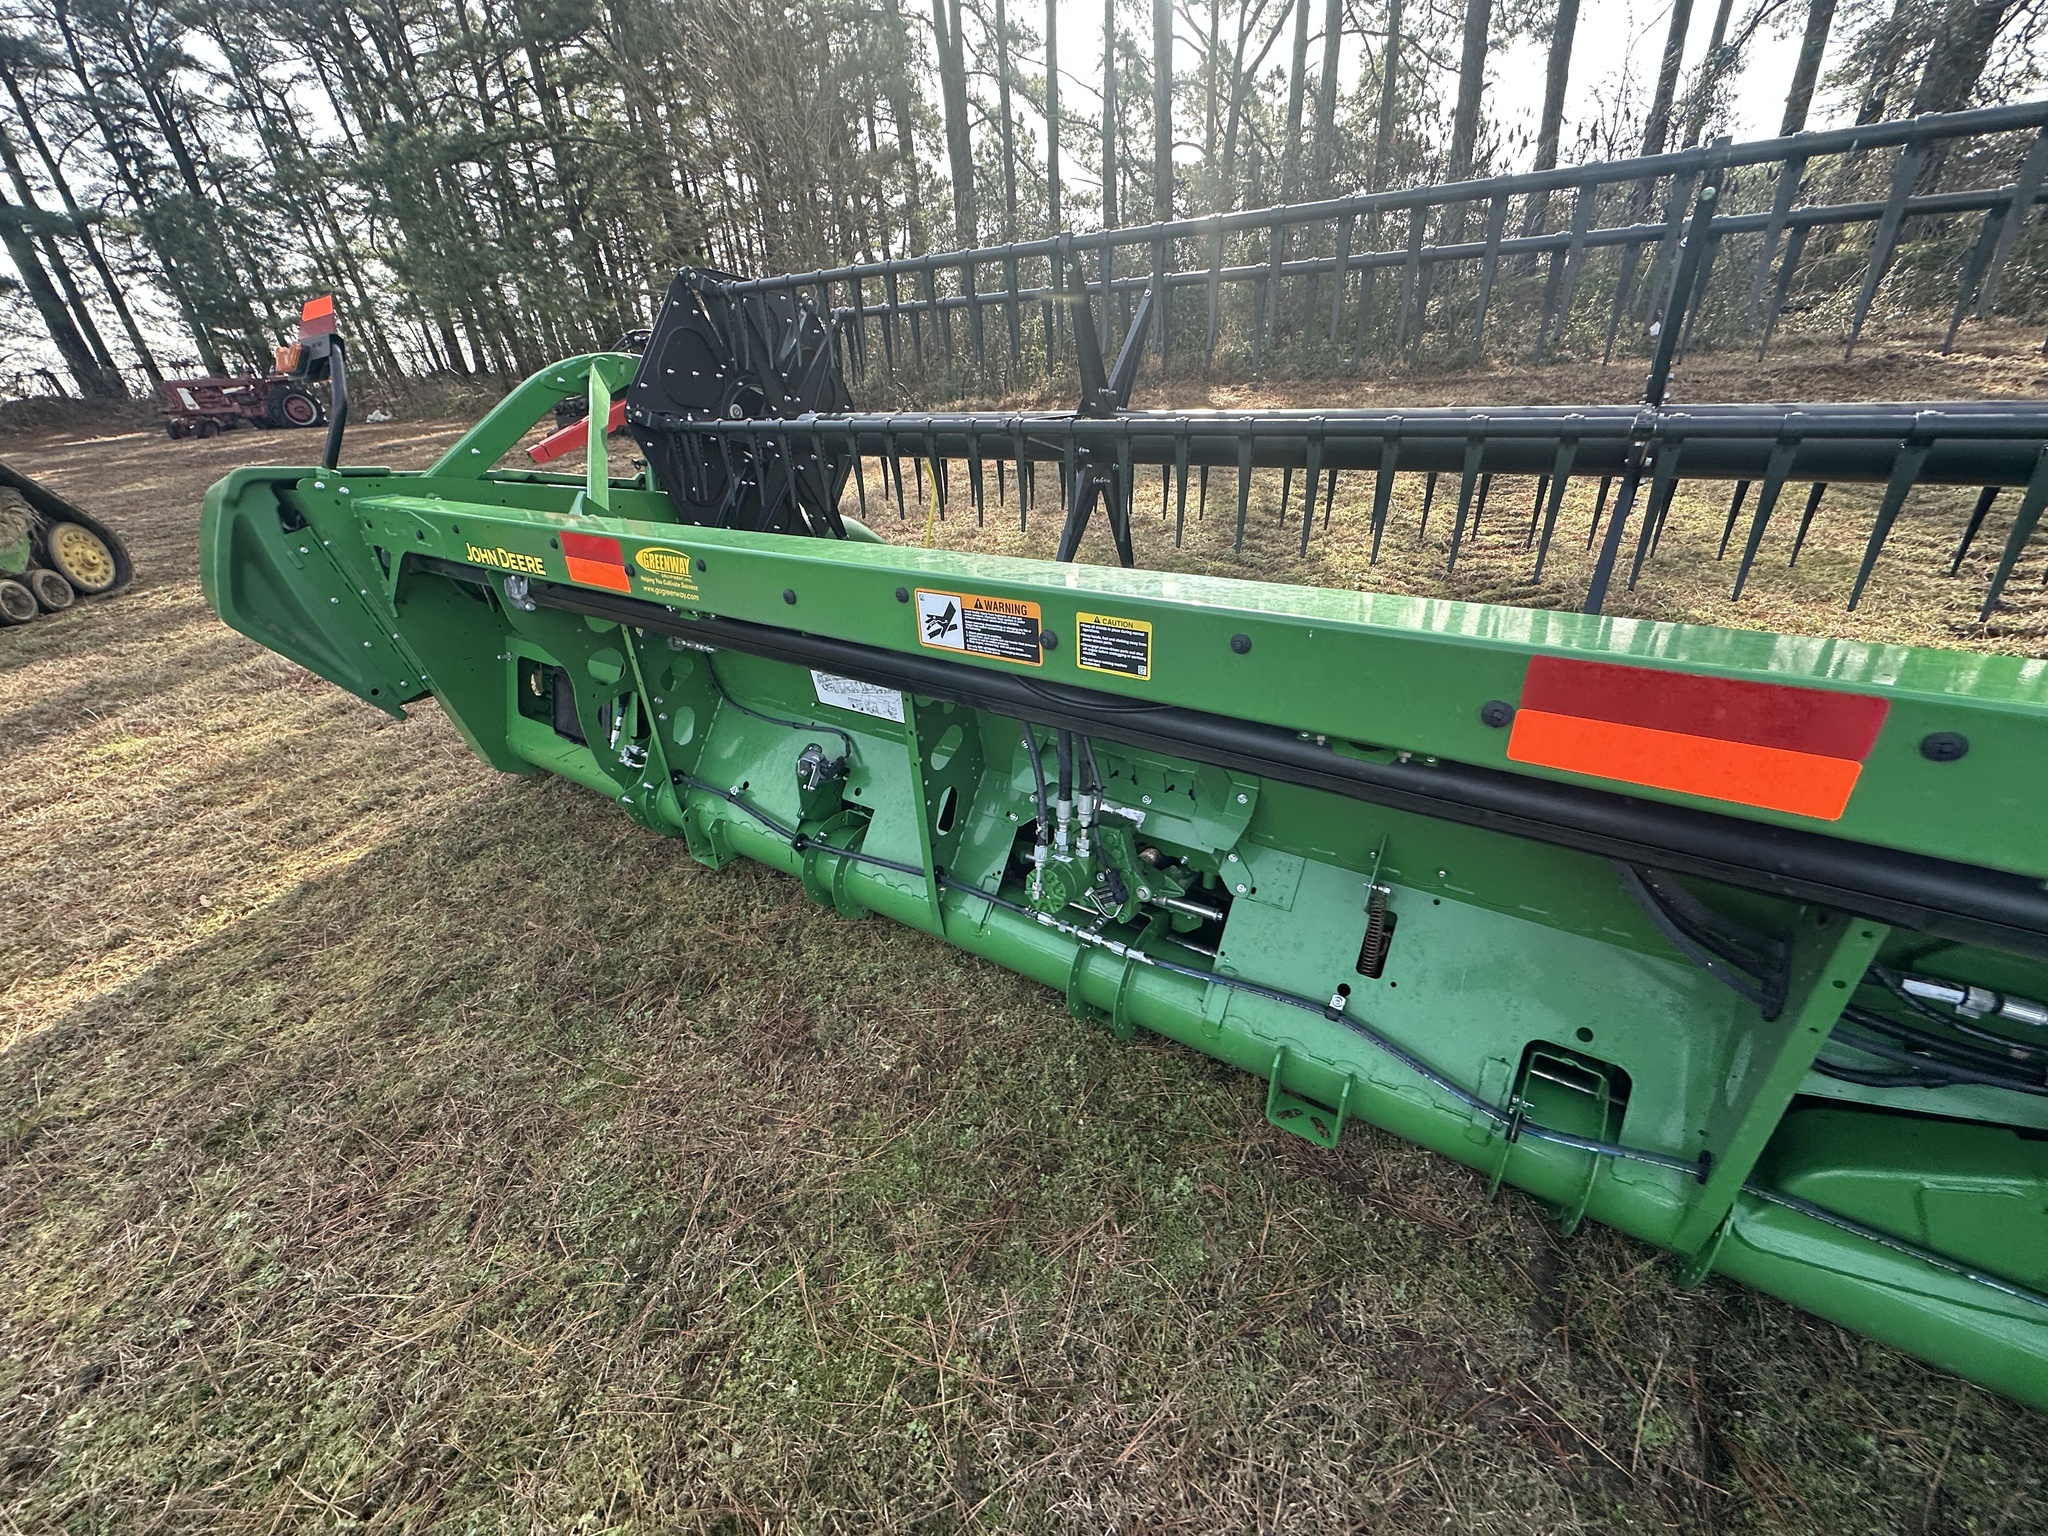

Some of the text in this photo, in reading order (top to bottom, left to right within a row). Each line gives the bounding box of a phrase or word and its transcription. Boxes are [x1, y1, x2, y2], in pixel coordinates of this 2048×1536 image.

[466, 542, 546, 576] JOHN DEERE
[643, 552, 690, 575] GREENWAY
[642, 586, 700, 601] www.gogreenway.com
[983, 600, 1027, 616] WARNING
[1102, 618, 1133, 628] CAUTION
